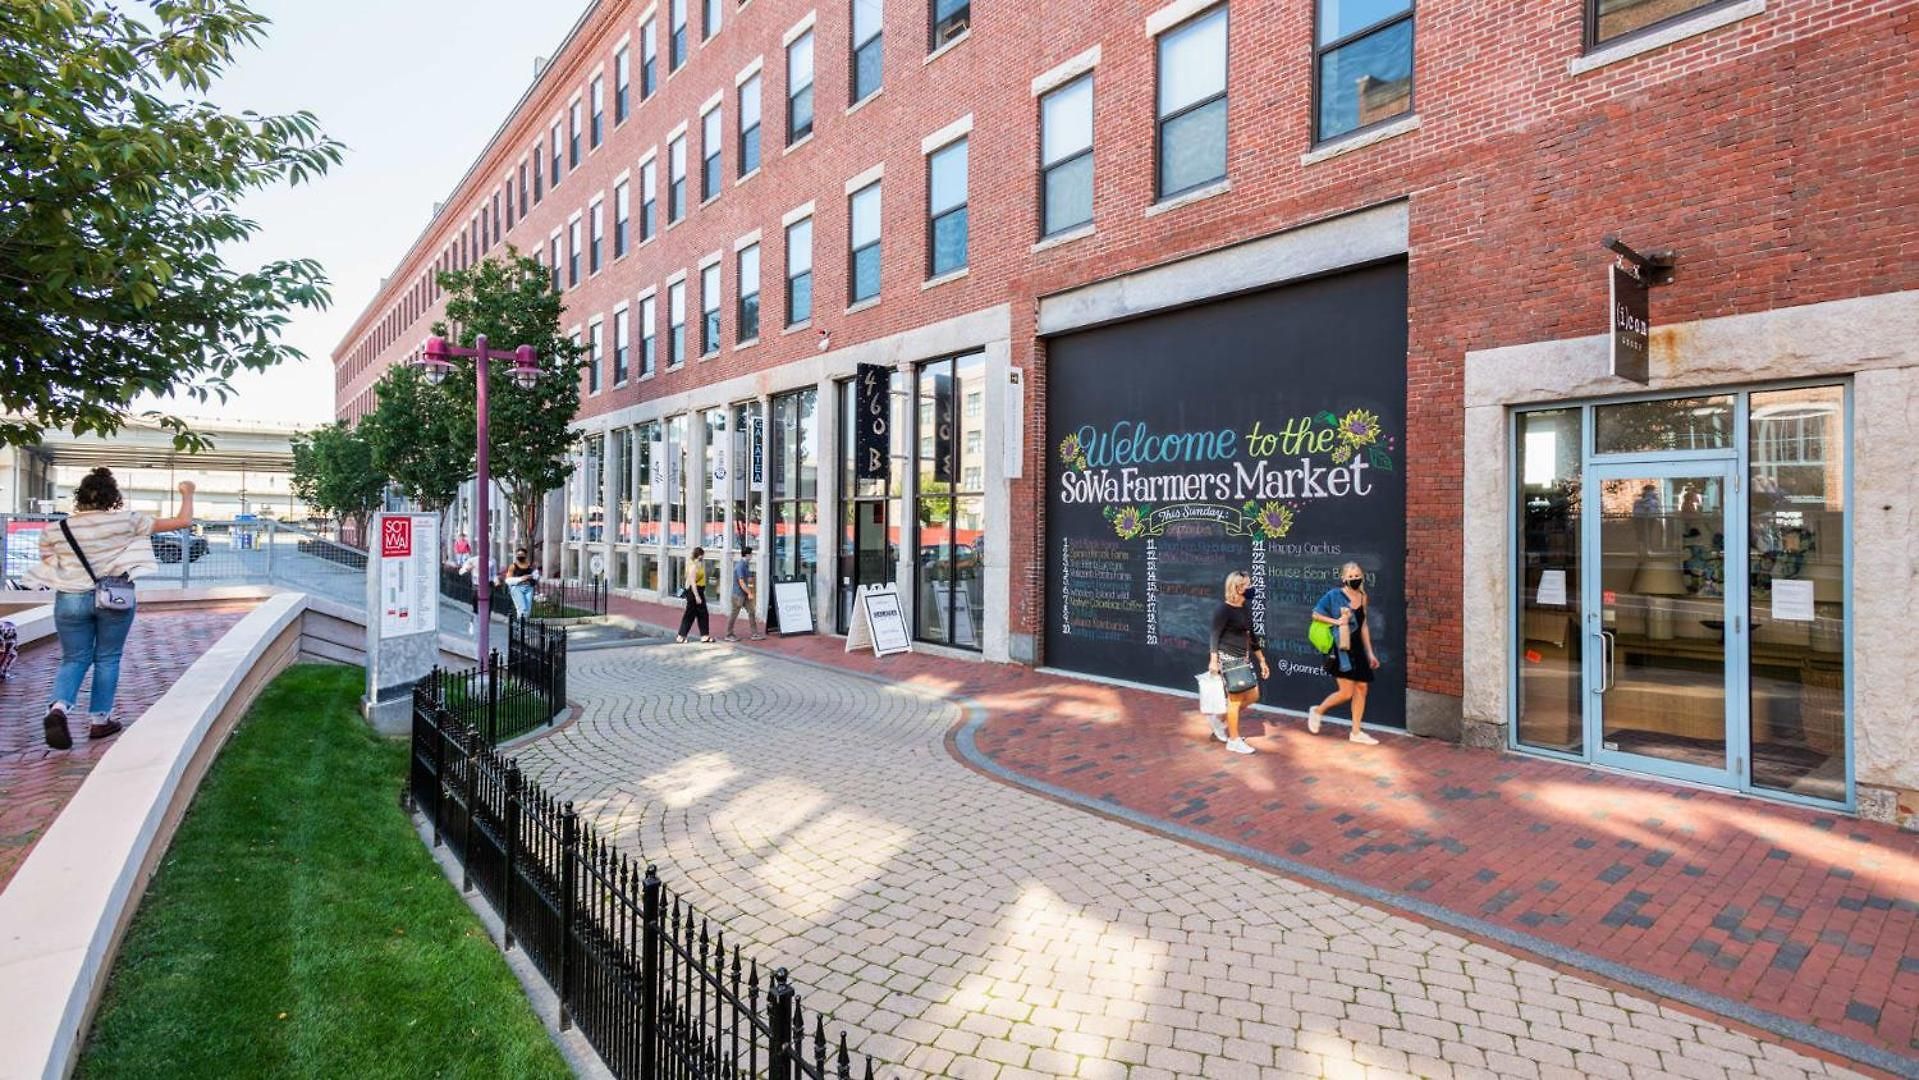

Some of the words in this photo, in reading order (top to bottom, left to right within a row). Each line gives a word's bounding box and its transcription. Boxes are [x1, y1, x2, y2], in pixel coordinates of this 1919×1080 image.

[753, 419, 763, 483] GALATEA
[1078, 421, 1237, 468] Welcome
[1246, 421, 1277, 456] to
[1279, 416, 1335, 455] the
[1120, 467, 1231, 502] Farmers
[1233, 453, 1372, 500] Market
[1158, 509, 1181, 522] This
[1268, 541, 1301, 556] Happy
[1304, 541, 1341, 555] Cactus
[1268, 566, 1300, 578] House
